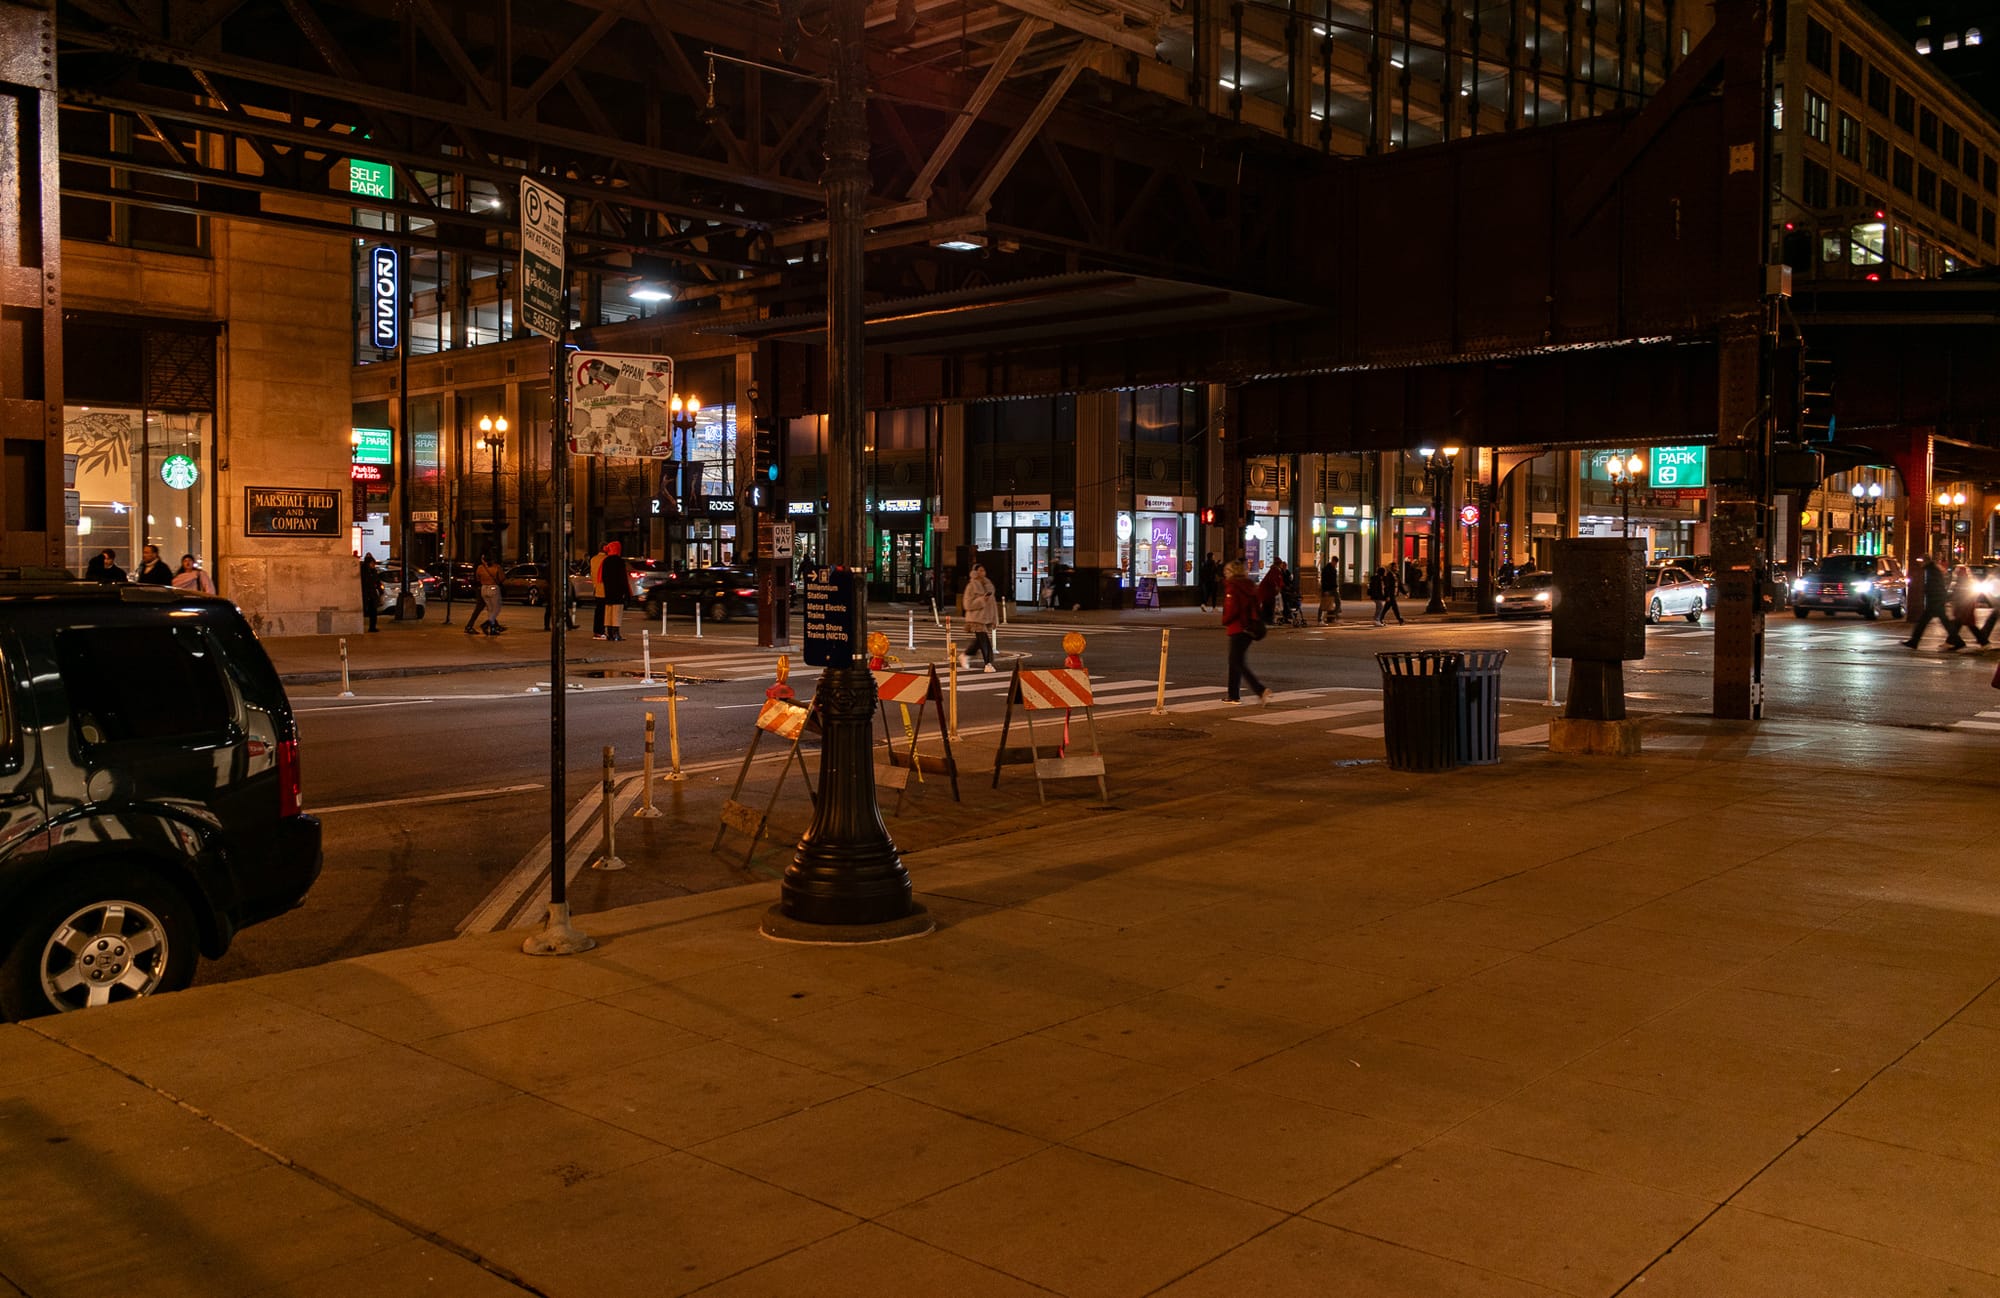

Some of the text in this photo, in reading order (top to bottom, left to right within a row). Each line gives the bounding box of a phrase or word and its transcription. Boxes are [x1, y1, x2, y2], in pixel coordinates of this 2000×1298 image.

[350, 166, 381, 183] SELF
[350, 180, 385, 198] PARK
[377, 257, 395, 338] ROSS
[1659, 452, 1697, 465] PARK
[352, 465, 378, 473] Public
[351, 472, 381, 480] Parking
[255, 494, 334, 509] MARSHALL FIELD
[709, 501, 735, 511] ROSS
[285, 509, 305, 517] AND
[271, 517, 319, 530] COMPANY
[775, 526, 790, 535] ONE
[775, 536, 791, 544] WAY
[807, 583, 838, 592] Millennium
[807, 591, 829, 600] Station
[807, 602, 847, 613] Metra Electric
[807, 611, 825, 620] Trains
[807, 622, 843, 632] South Shore
[807, 630, 849, 642] Trains (NICTD)
